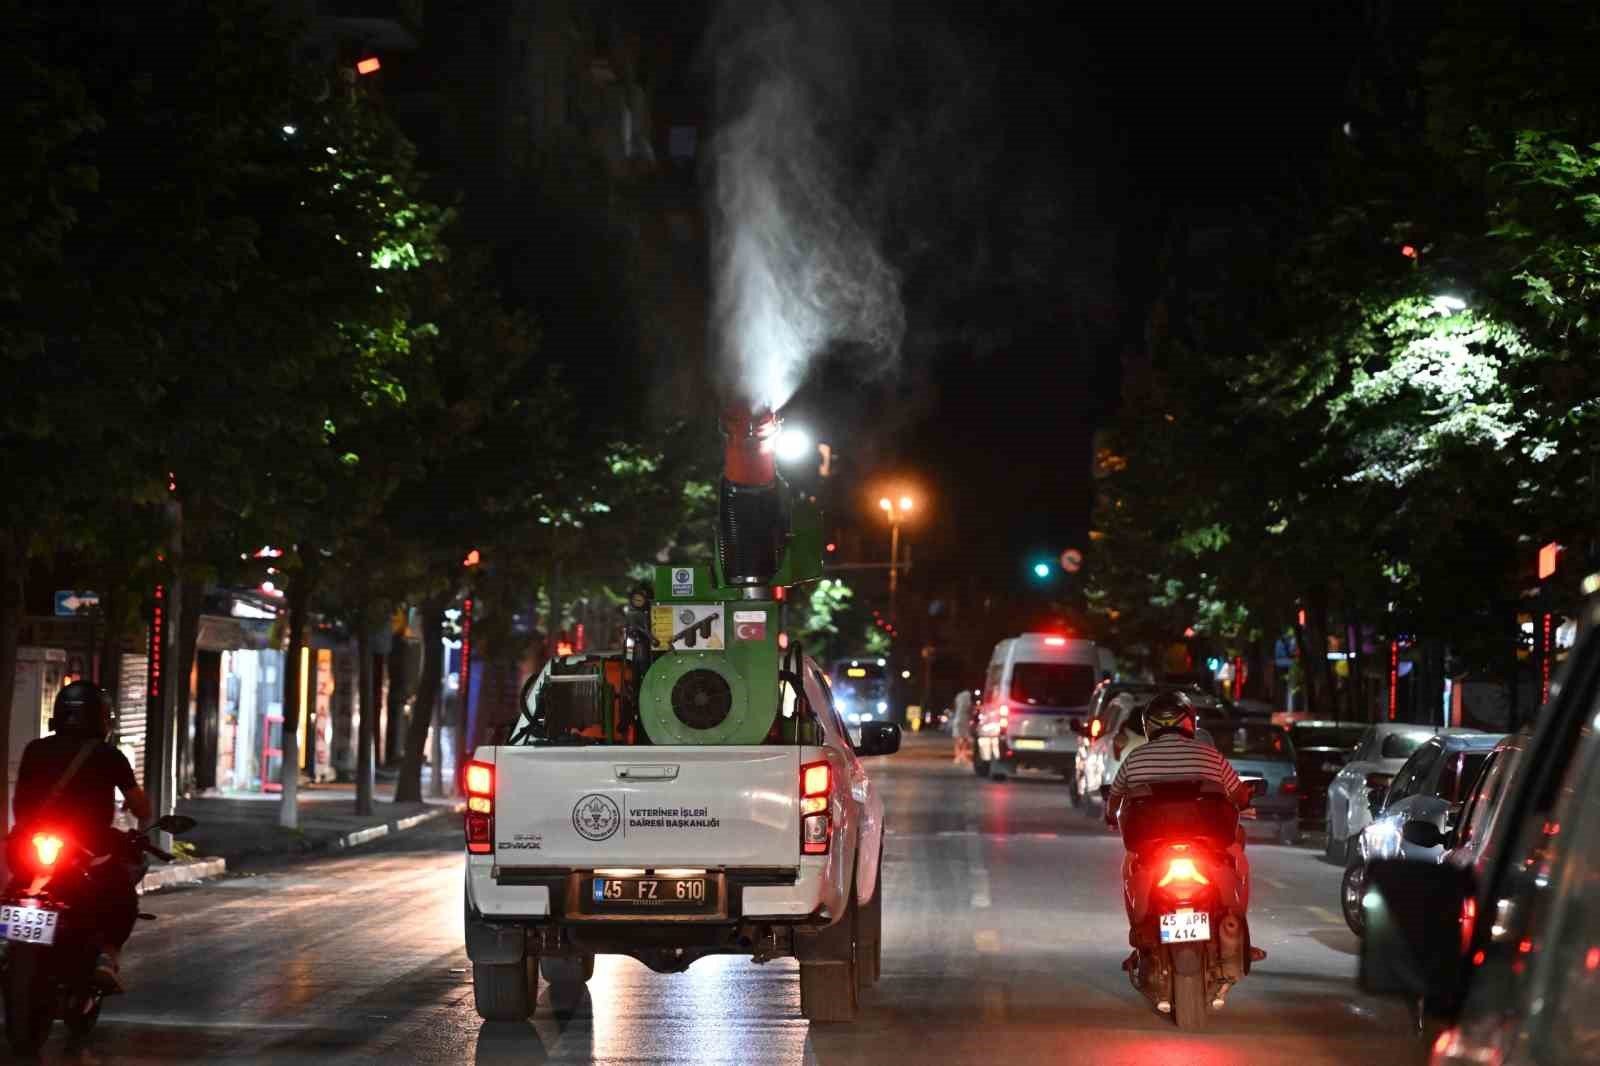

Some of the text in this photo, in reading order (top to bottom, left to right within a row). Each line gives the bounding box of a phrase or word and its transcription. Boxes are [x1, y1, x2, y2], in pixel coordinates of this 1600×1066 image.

[629, 806, 708, 818] VETERİNER İŞLERİ
[629, 817, 664, 827] DAİRESİ
[604, 880, 701, 899] 45 FZ 610
[1162, 914, 1208, 926] 45 APR
[1174, 929, 1197, 939] 414
